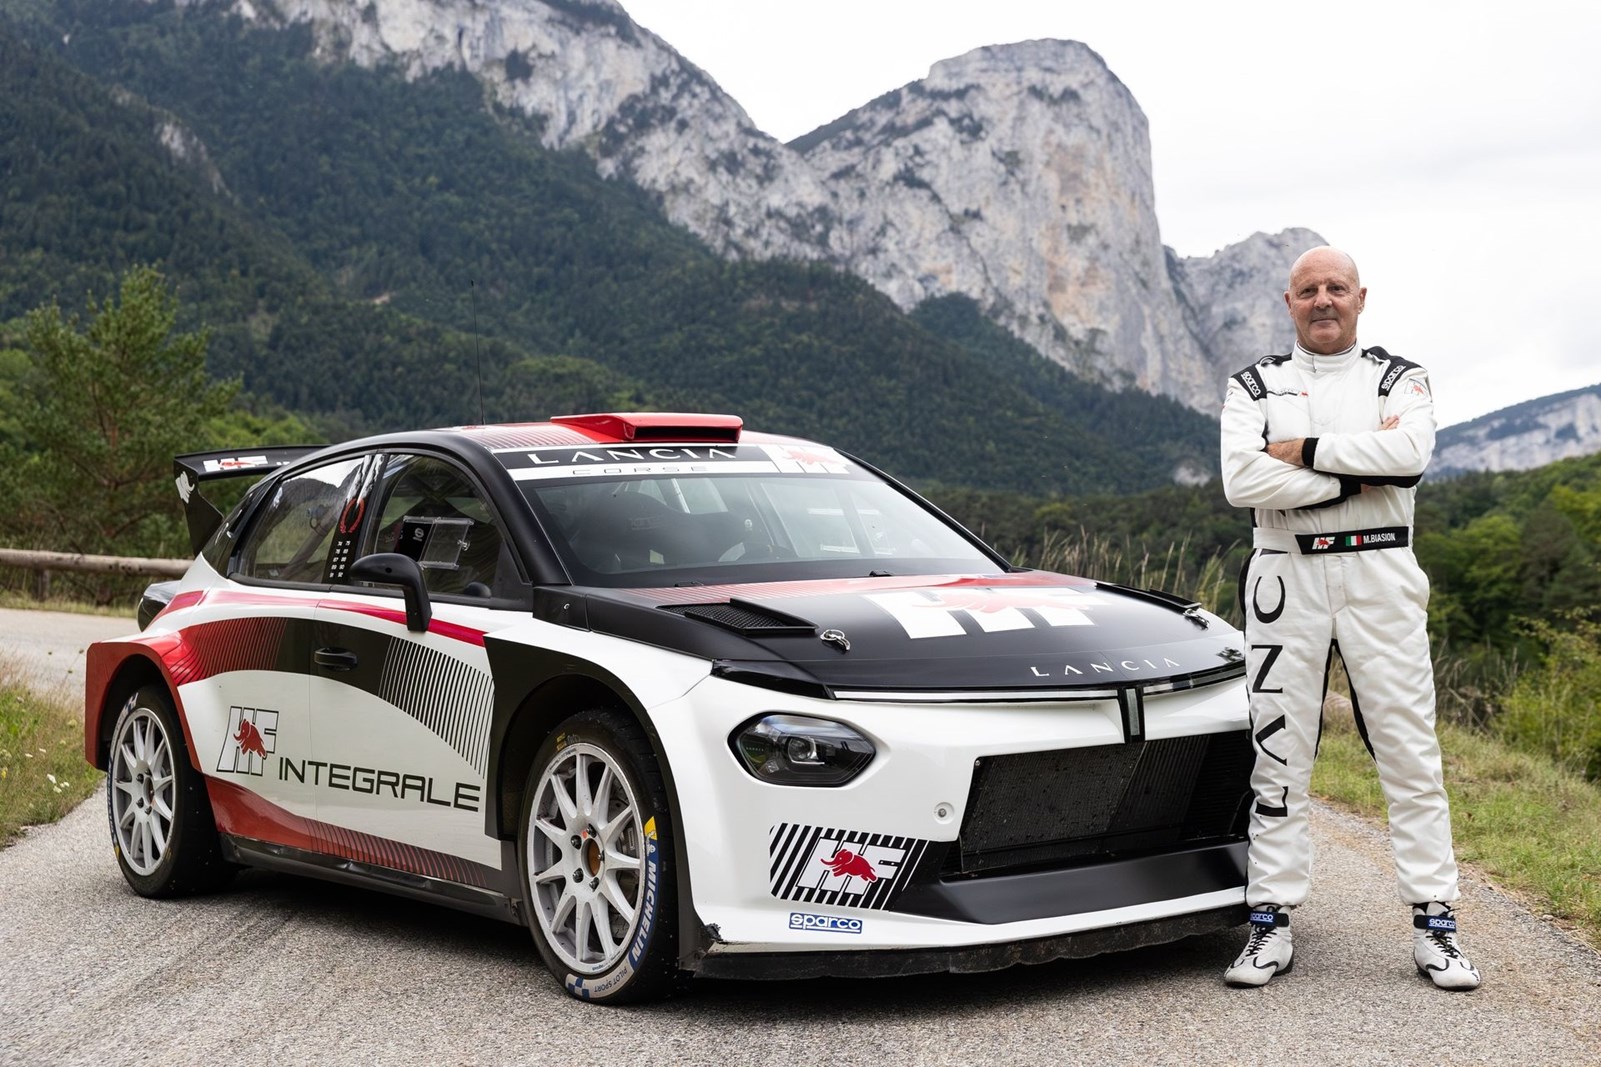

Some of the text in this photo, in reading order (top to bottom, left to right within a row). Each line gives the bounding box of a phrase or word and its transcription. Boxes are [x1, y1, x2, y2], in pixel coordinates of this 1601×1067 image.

[1241, 371, 1262, 397] sparco
[1381, 365, 1406, 391] sparco
[527, 448, 737, 465] LANCIA
[572, 466, 708, 476] CORSE
[1363, 532, 1397, 545] M.BIASION
[1029, 656, 1180, 677] LANCIA
[278, 756, 481, 812] INTEGRALE
[631, 860, 657, 963] MICHELIN
[790, 913, 861, 933] sparco
